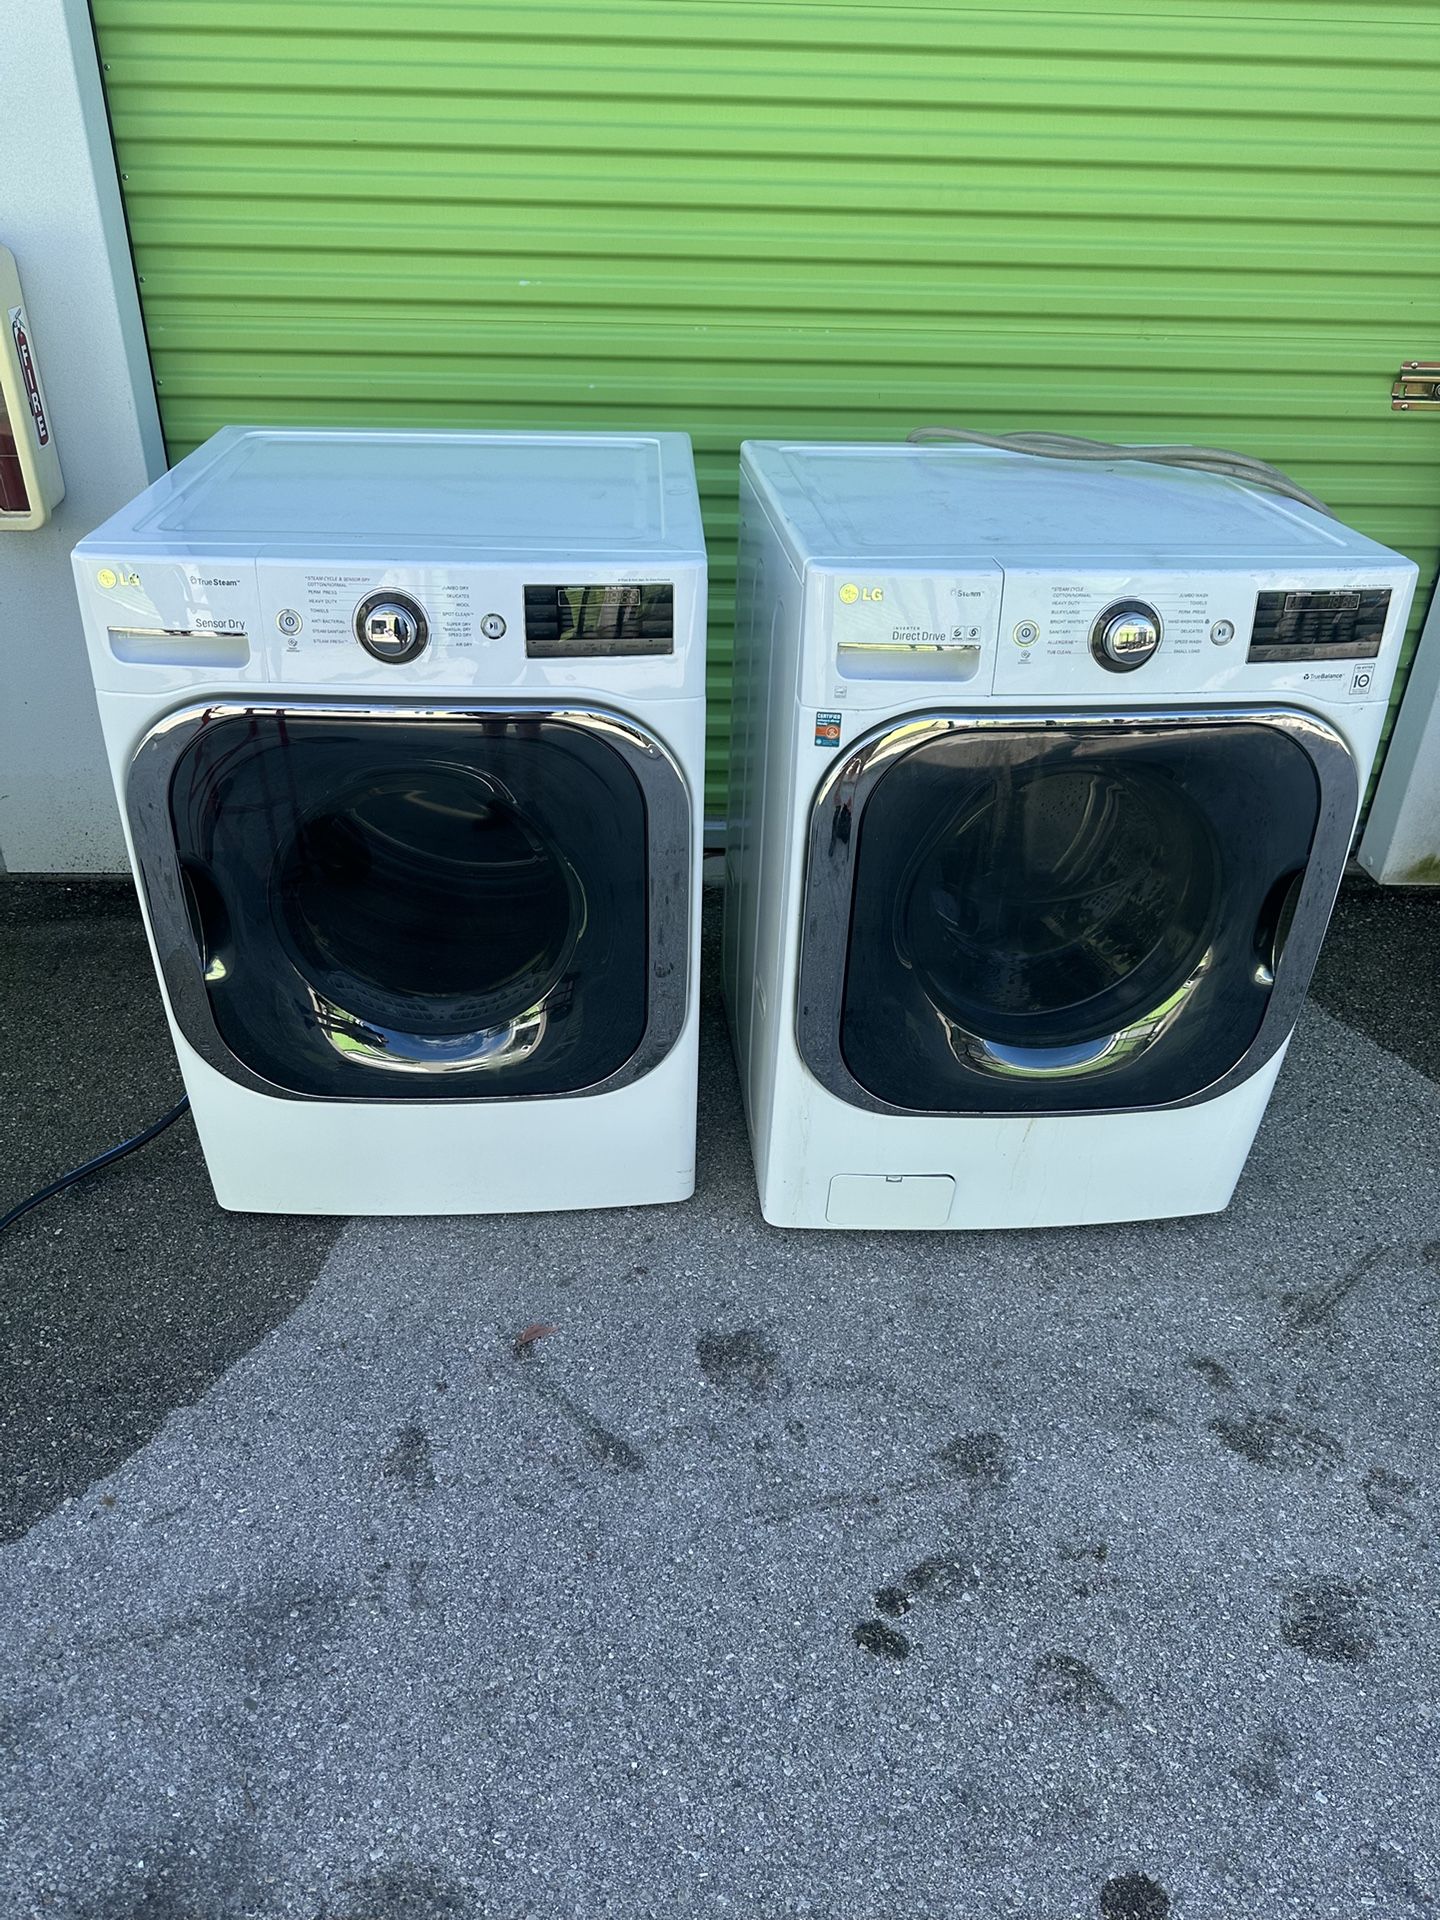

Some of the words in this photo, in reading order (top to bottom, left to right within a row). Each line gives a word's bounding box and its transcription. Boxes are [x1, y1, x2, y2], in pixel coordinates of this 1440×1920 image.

[21, 344, 47, 437] FIRE
[118, 572, 141, 587] LG
[862, 588, 883, 601] LG
[195, 618, 227, 629] Sensor
[228, 619, 246, 631] Dry
[892, 631, 921, 641] Direct
[922, 631, 946, 641] Drive
[1353, 674, 1370, 688] 10
